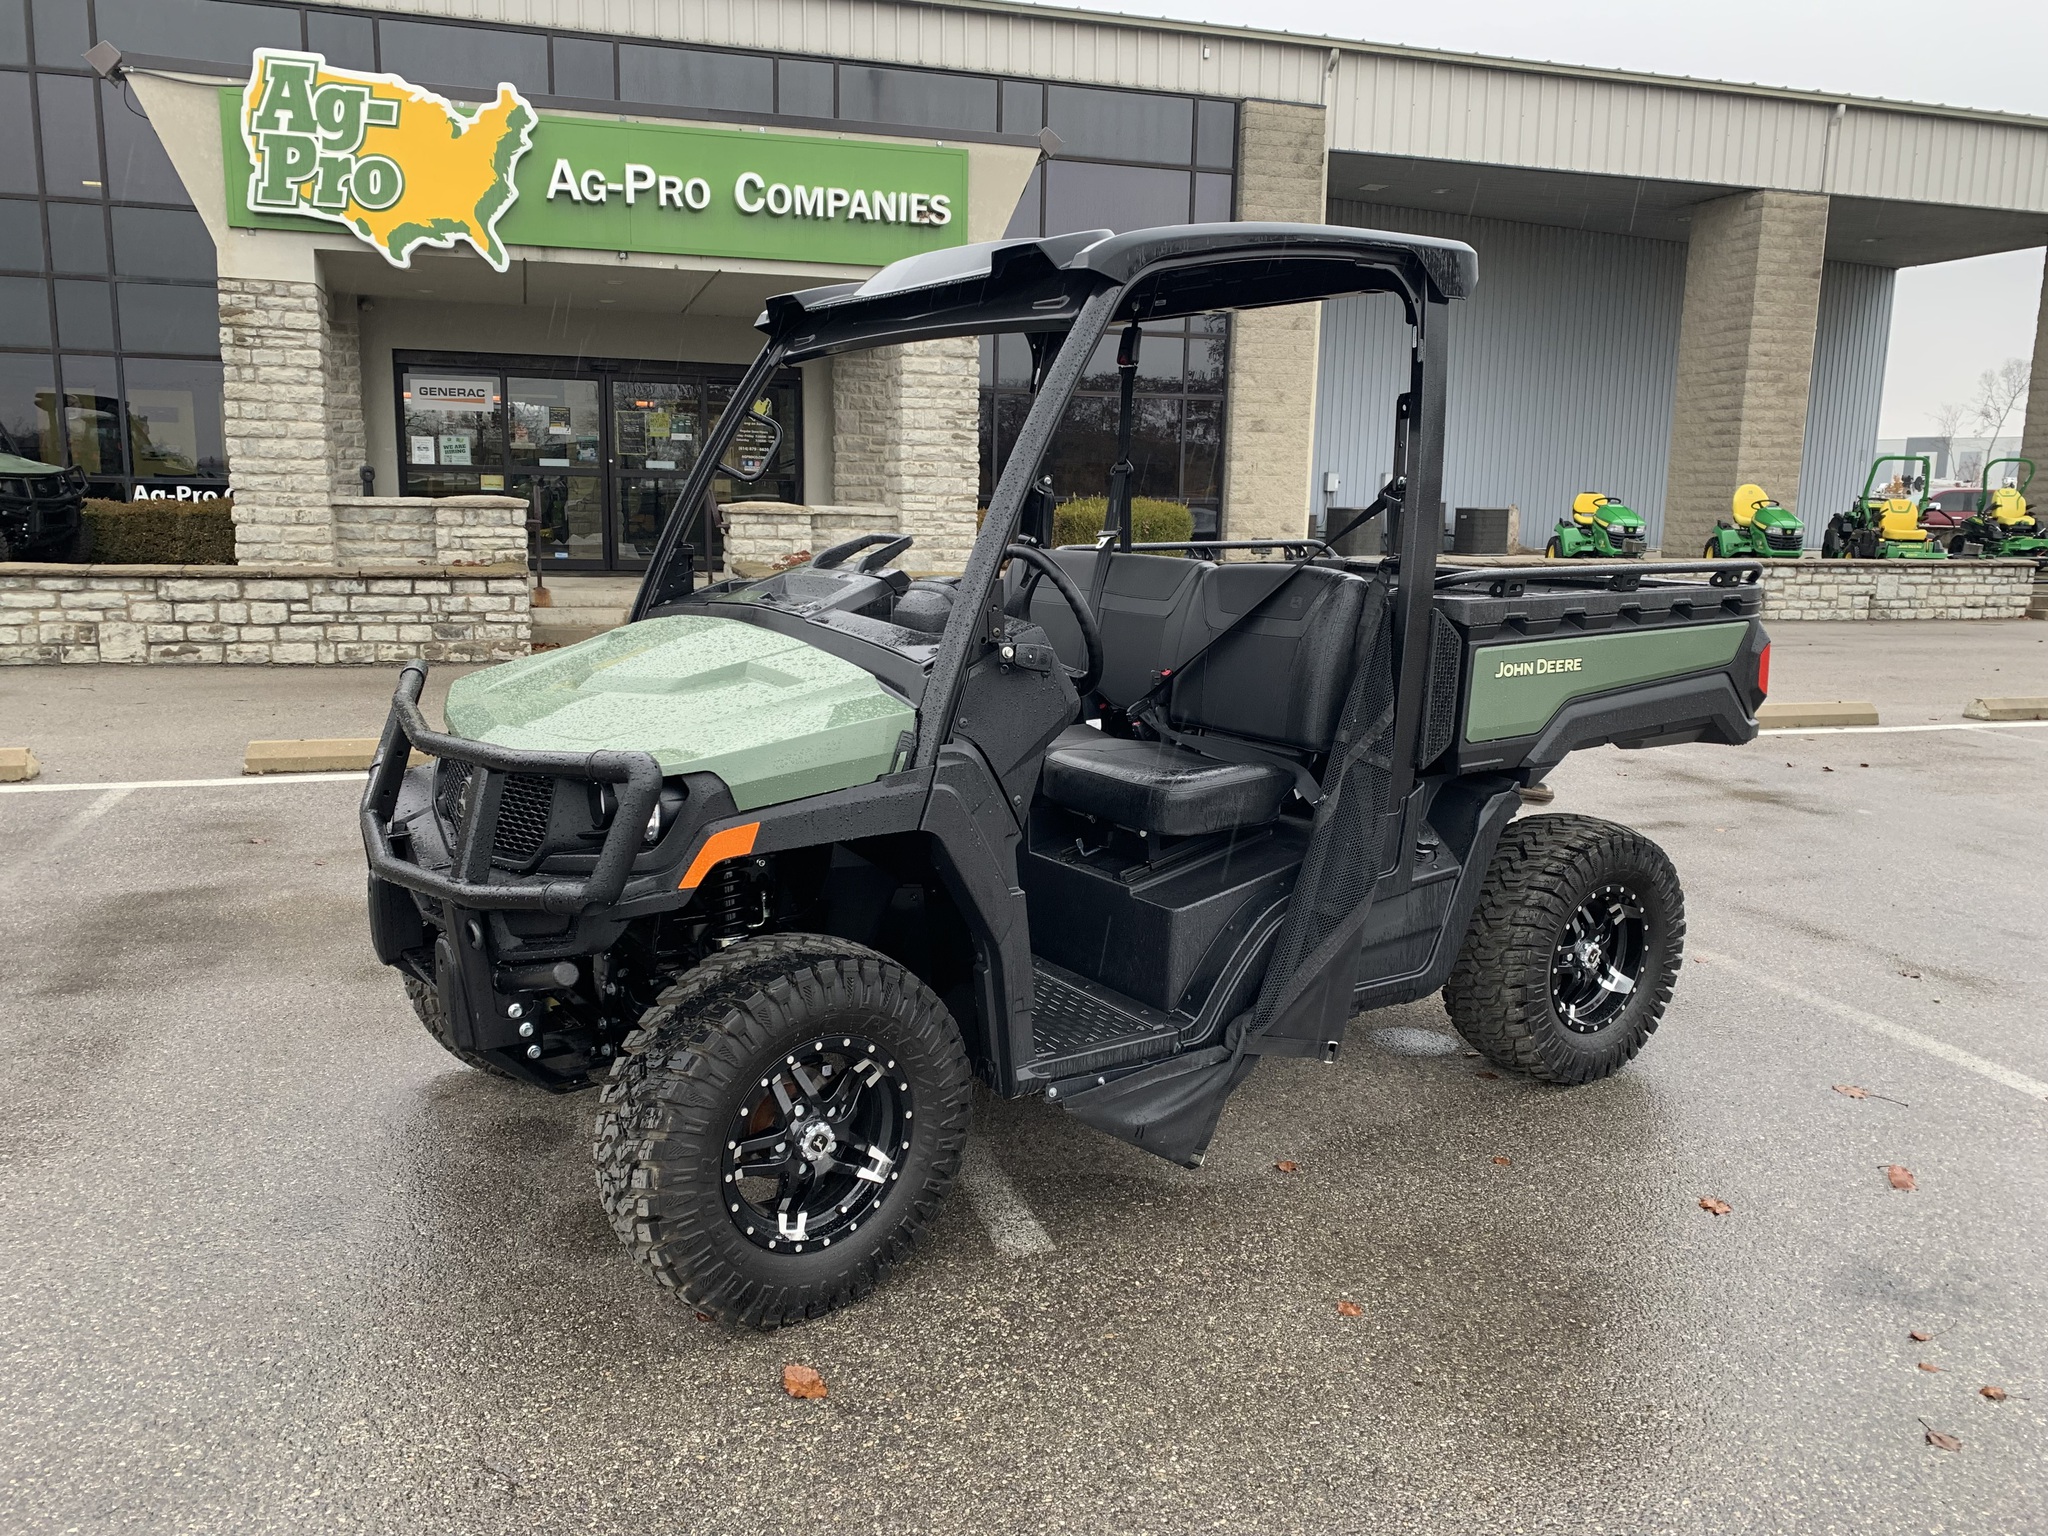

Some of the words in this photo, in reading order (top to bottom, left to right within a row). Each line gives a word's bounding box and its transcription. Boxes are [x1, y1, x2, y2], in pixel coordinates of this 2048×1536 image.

[251, 59, 399, 154] Ag-
[257, 133, 403, 210] Pro
[546, 158, 711, 210] AG-PRO
[734, 171, 952, 226] COMPANIES
[419, 386, 486, 398] GENERAC
[1494, 661, 1534, 679] JOHN
[1536, 657, 1583, 675] DEERE
